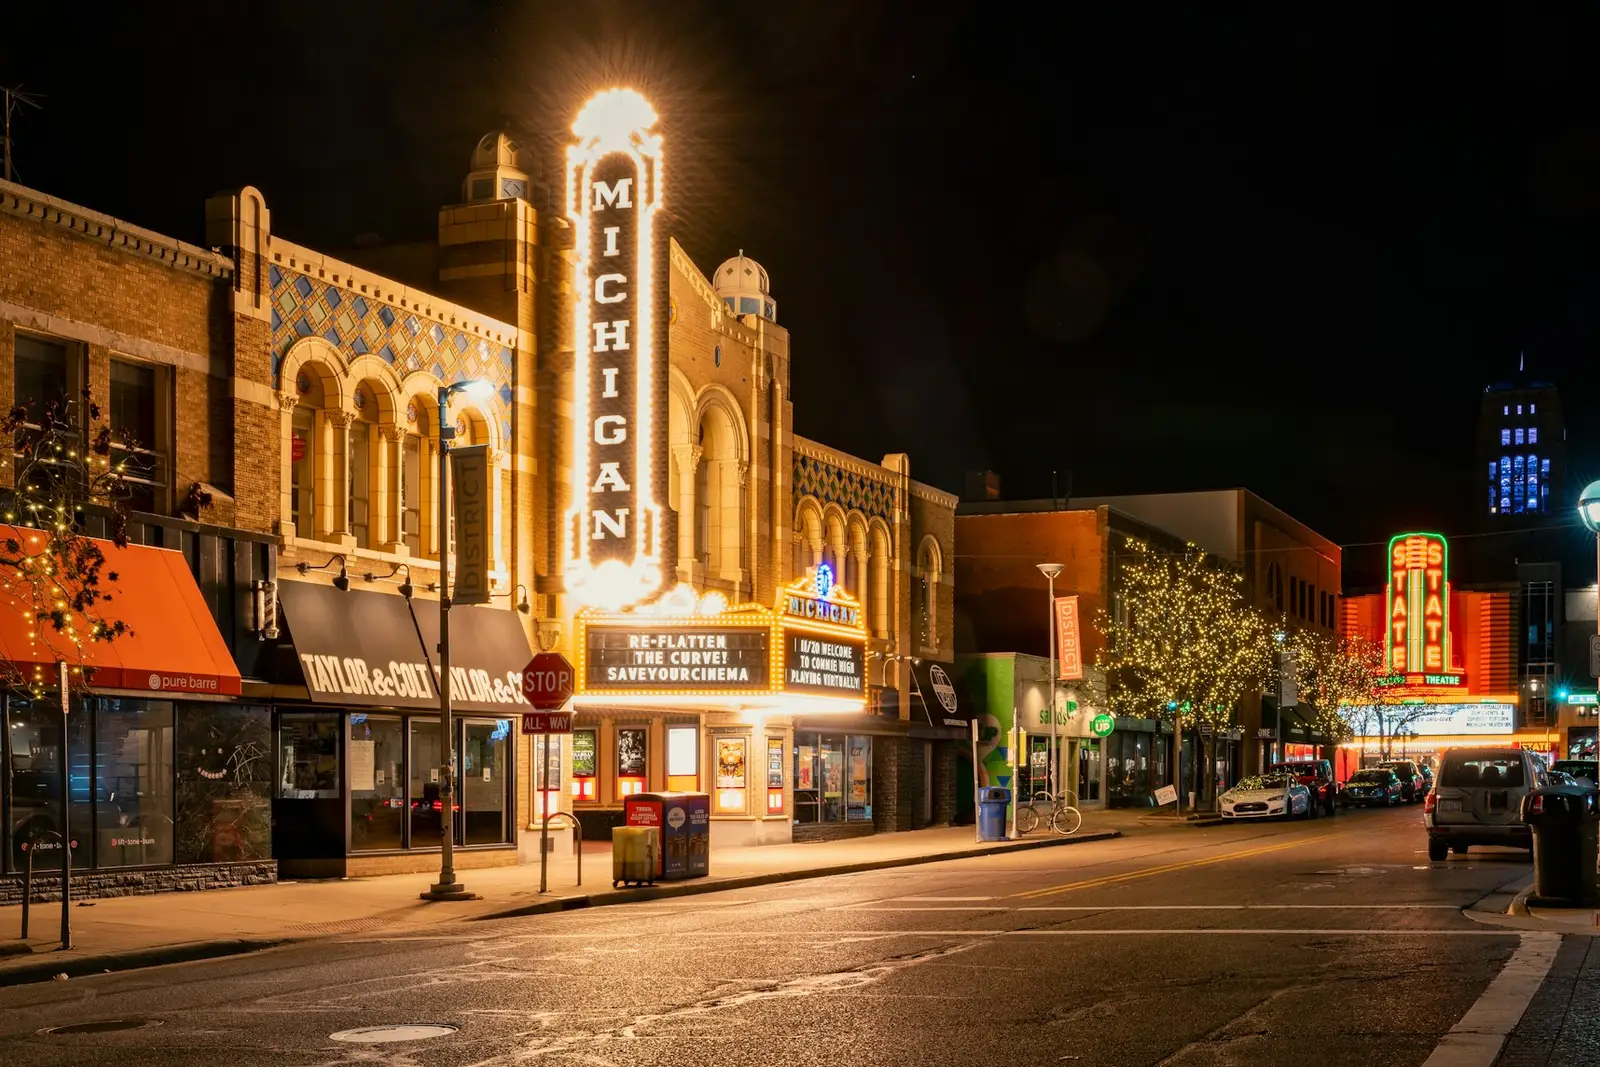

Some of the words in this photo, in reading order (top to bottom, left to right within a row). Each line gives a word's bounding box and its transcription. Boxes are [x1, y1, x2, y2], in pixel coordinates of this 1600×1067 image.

[591, 177, 632, 540] MICHIGAN
[460, 460, 480, 590] DISTRICT
[788, 596, 857, 626] MICHIGAN
[1392, 545, 1407, 669] STATE
[1425, 543, 1442, 668] STATE
[629, 634, 726, 648] RE-FLATTEN
[1061, 603, 1077, 676] DISTRICT
[635, 651, 663, 665] THE
[670, 651, 728, 665] CURVE!
[821, 642, 853, 659] WELCOME
[800, 654, 810, 669] TO
[301, 653, 434, 699] TAYLOR&COLT
[525, 671, 569, 693] STOP
[608, 667, 749, 681] SAVEYOURCINEMA
[790, 669, 821, 686] PLAYING
[823, 672, 860, 690] VIRTUALLY
[1425, 675, 1460, 684] THEATRE
[162, 677, 187, 690] pure
[189, 677, 217, 690] barre
[524, 718, 542, 730] ALL
[549, 716, 569, 730] WAY
[1095, 722, 1111, 732] UP
[1521, 742, 1552, 751] STATE
